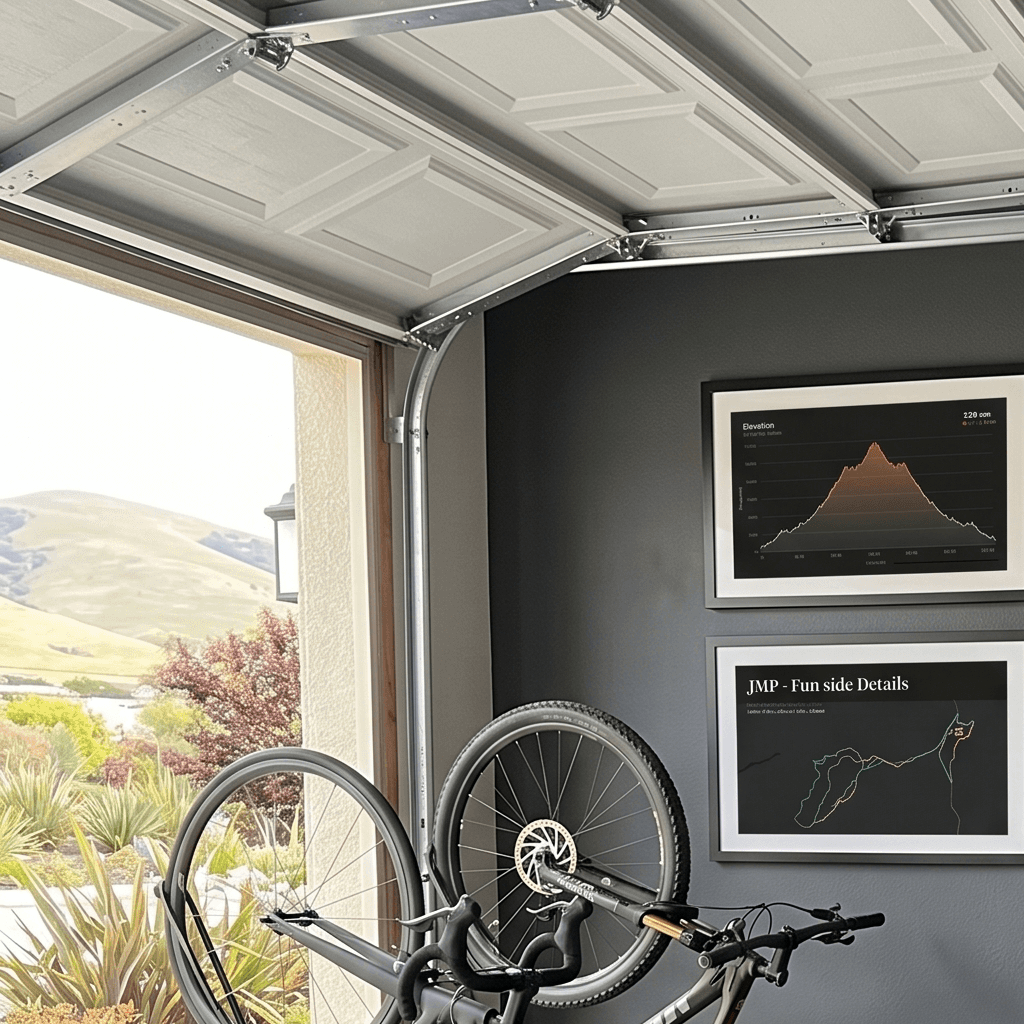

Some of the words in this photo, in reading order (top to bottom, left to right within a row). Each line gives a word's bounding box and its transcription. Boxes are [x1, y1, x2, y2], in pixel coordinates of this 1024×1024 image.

[742, 421, 775, 431] Elevation
[746, 679, 779, 696] JMP
[791, 678, 820, 693] Fun
[823, 677, 854, 692] side
[857, 675, 909, 692] Details
